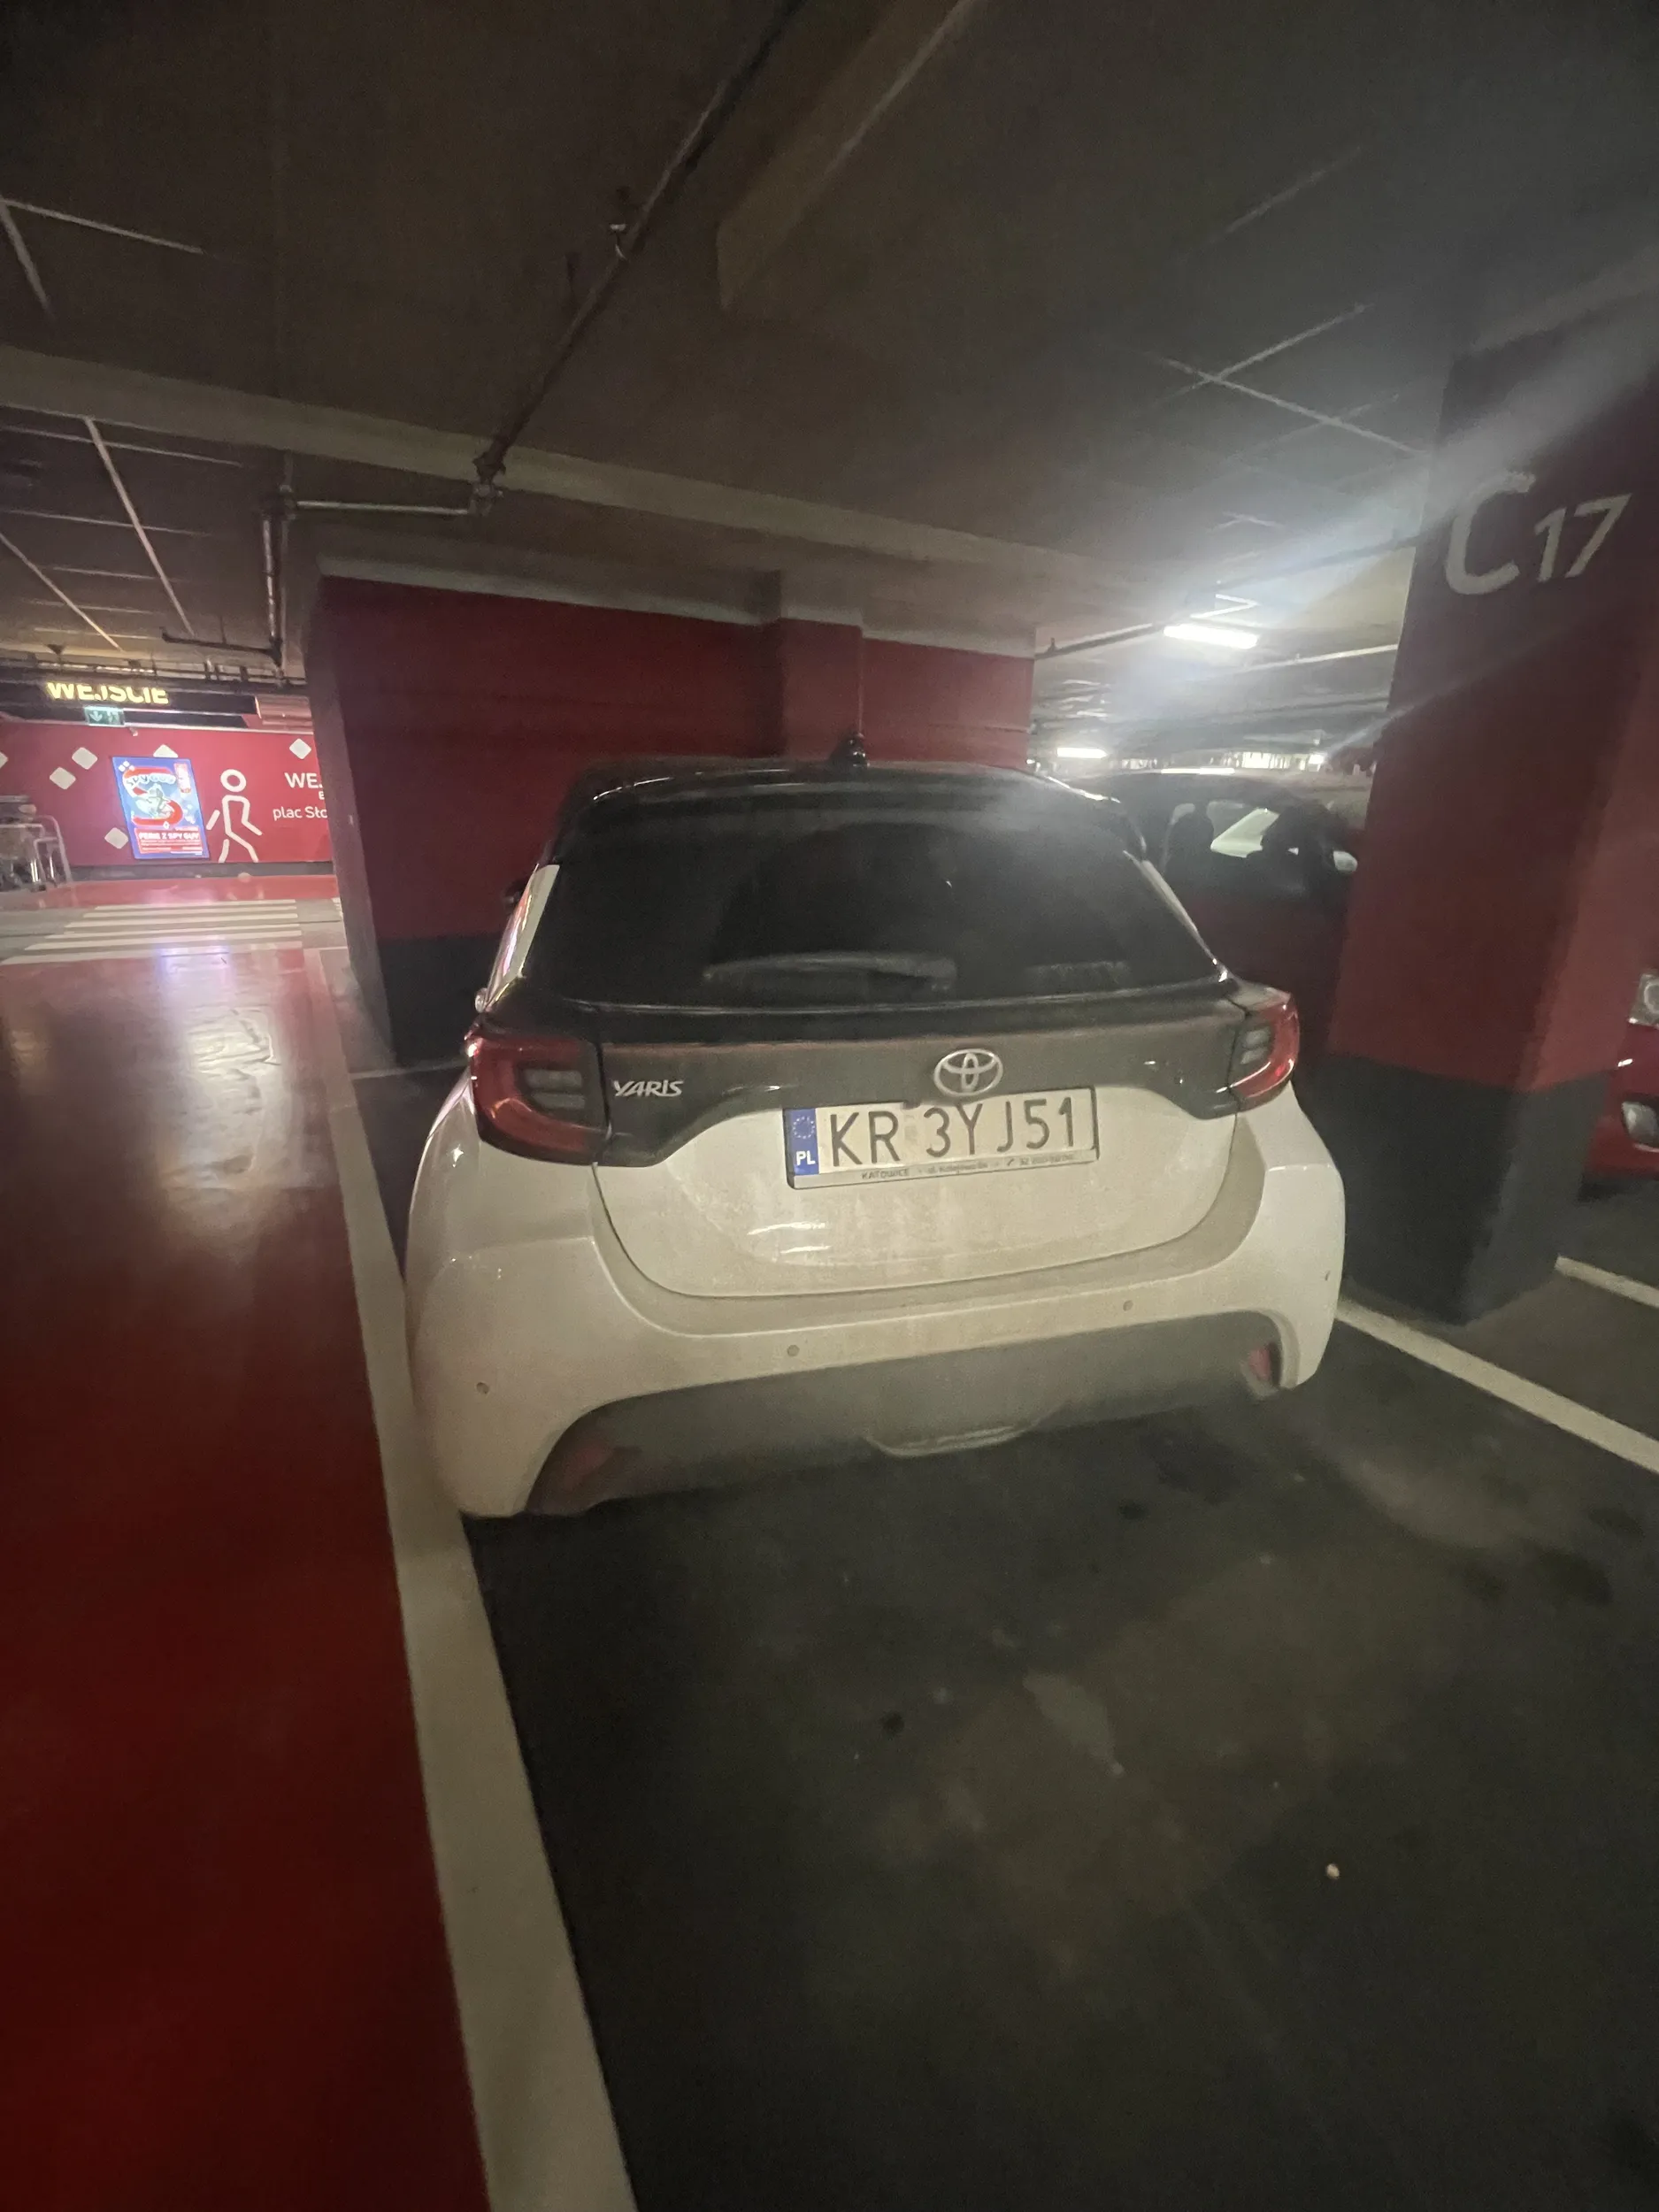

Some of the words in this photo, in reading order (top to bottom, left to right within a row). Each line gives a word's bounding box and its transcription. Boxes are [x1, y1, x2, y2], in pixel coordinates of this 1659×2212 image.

[1445, 471, 1632, 595] C17
[284, 772, 323, 789] WE
[273, 806, 303, 821] plac
[613, 1079, 684, 1097] YARIS
[829, 1111, 901, 1167] KR
[922, 1095, 1075, 1158] 3YJ51
[795, 1150, 816, 1166] PL
